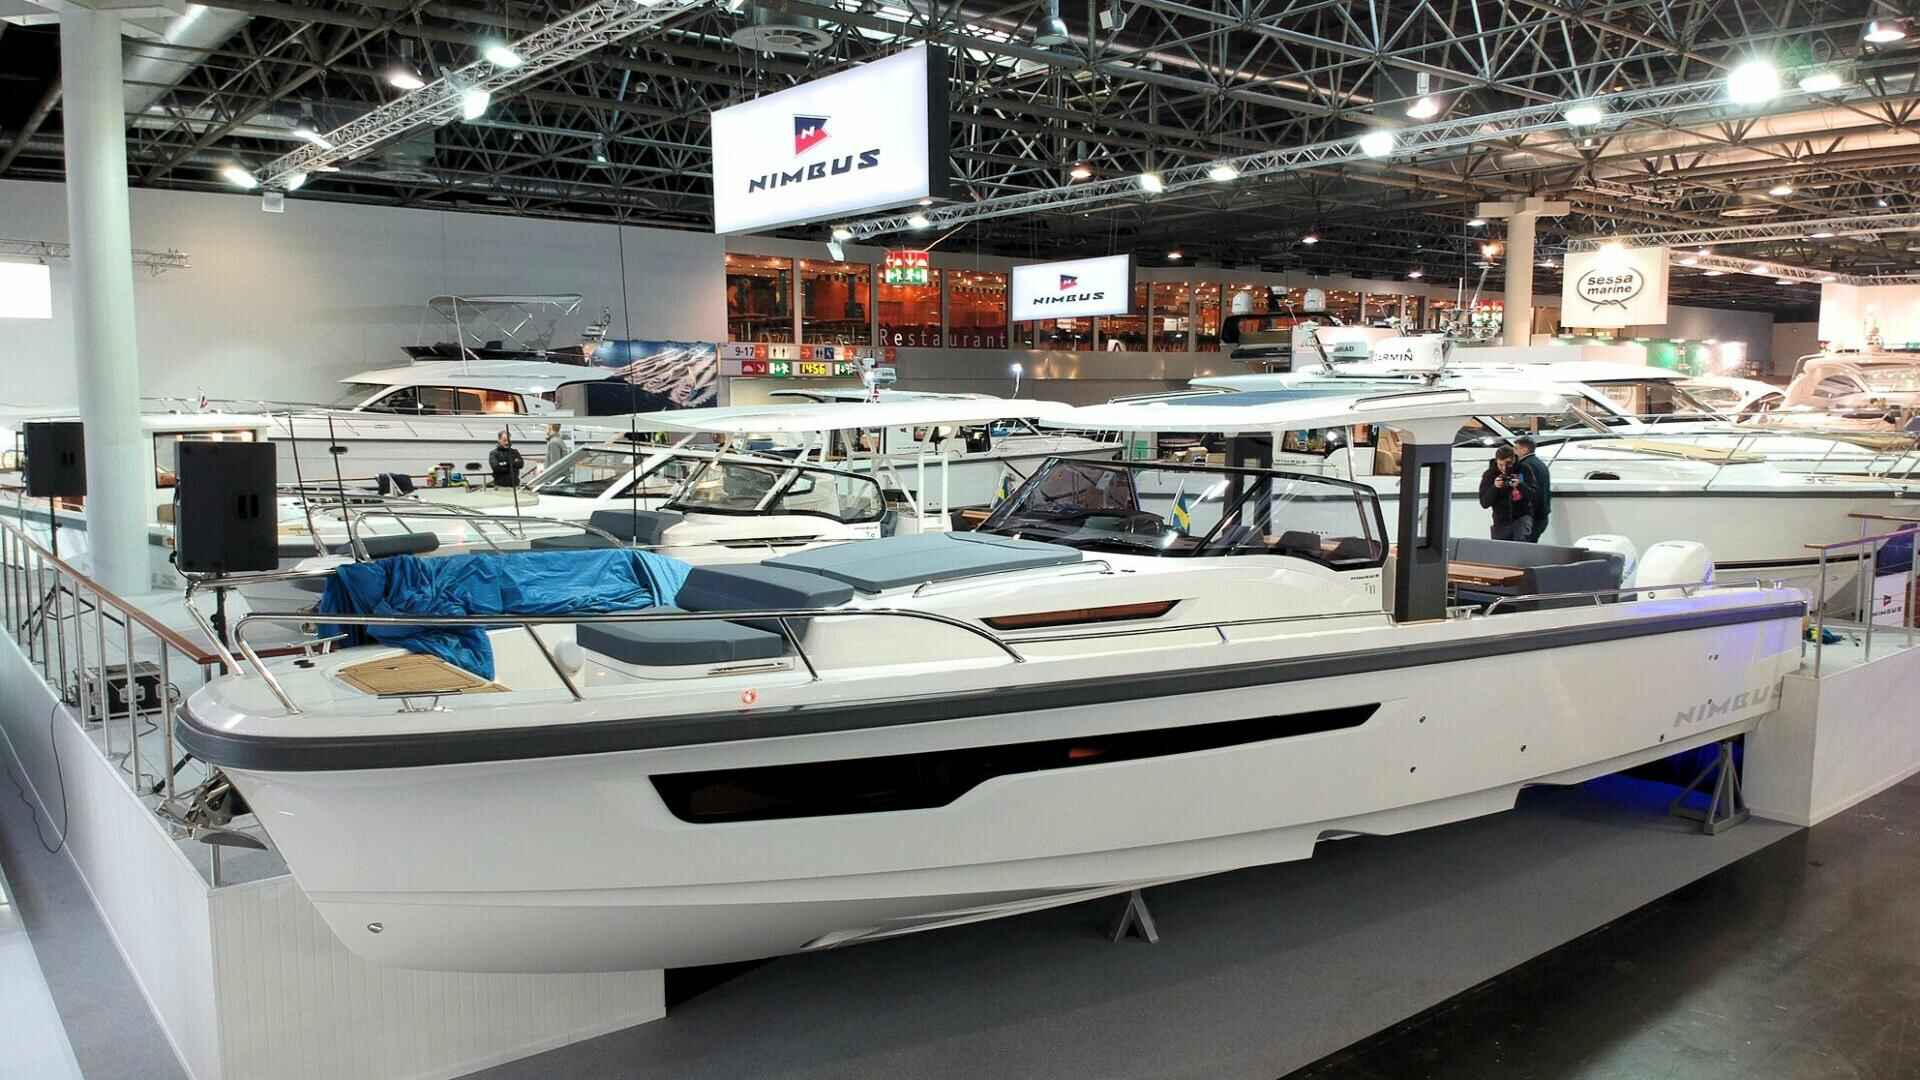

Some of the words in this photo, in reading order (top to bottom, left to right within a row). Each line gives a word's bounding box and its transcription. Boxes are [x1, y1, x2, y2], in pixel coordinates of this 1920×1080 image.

[749, 149, 881, 193] NIMBUS
[1587, 274, 1634, 286] sessa
[1587, 285, 1633, 295] marine
[1033, 292, 1105, 305] NIMBUS
[880, 328, 1008, 348] Restaurant
[1374, 353, 1413, 362] RMIN
